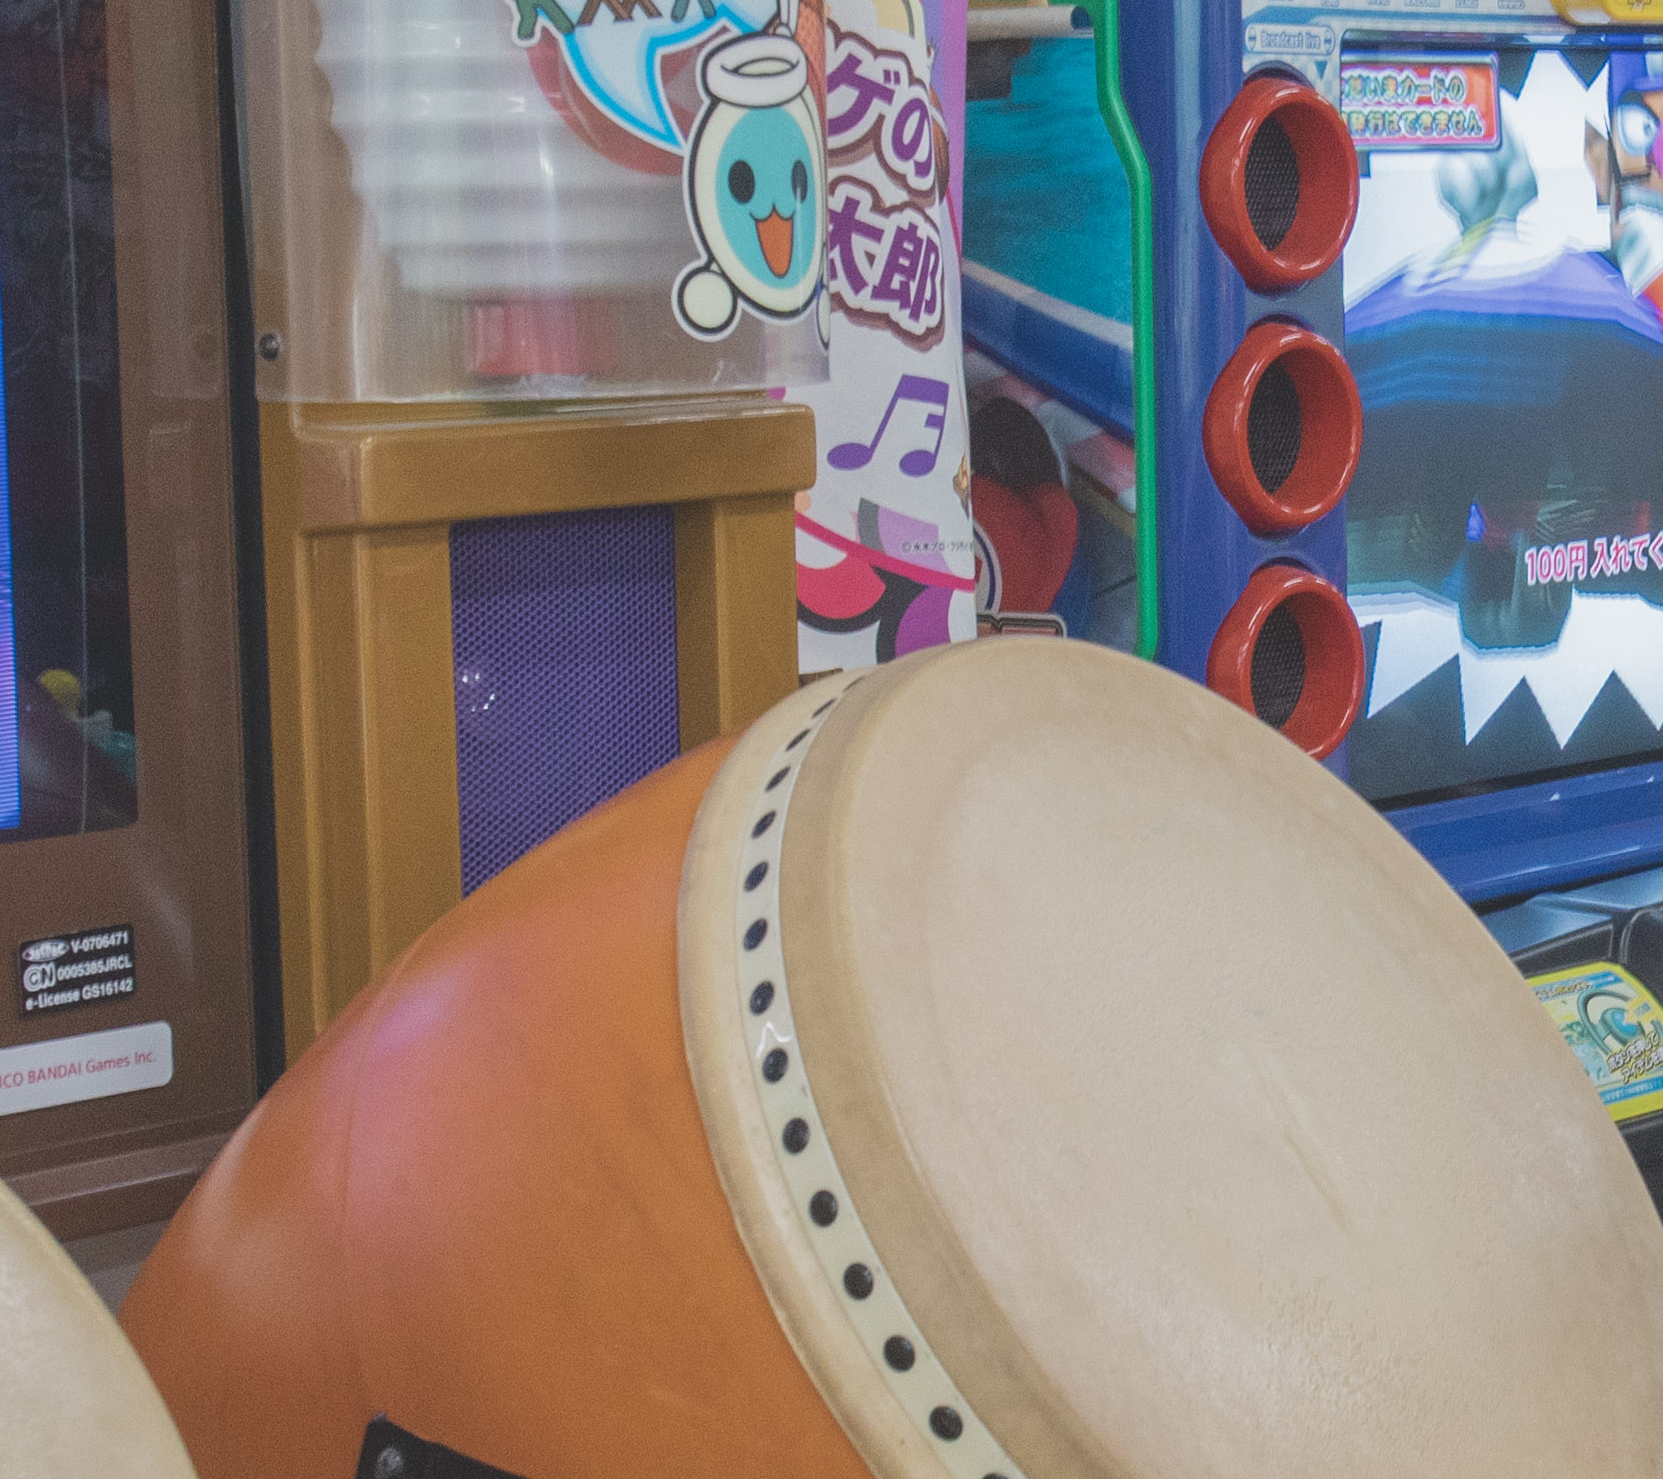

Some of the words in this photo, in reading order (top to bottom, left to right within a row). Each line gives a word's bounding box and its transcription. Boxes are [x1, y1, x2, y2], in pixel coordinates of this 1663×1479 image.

[1260, 28, 1304, 48] Broadcast
[1340, 72, 1468, 103] だいまカードの
[1524, 539, 1587, 585] 100円
[25, 988, 80, 1011] e-License
[82, 977, 134, 1000] GS16142
[27, 1063, 82, 1084] BANDAI
[85, 1054, 131, 1074] Games
[134, 1050, 157, 1066] Inc.
